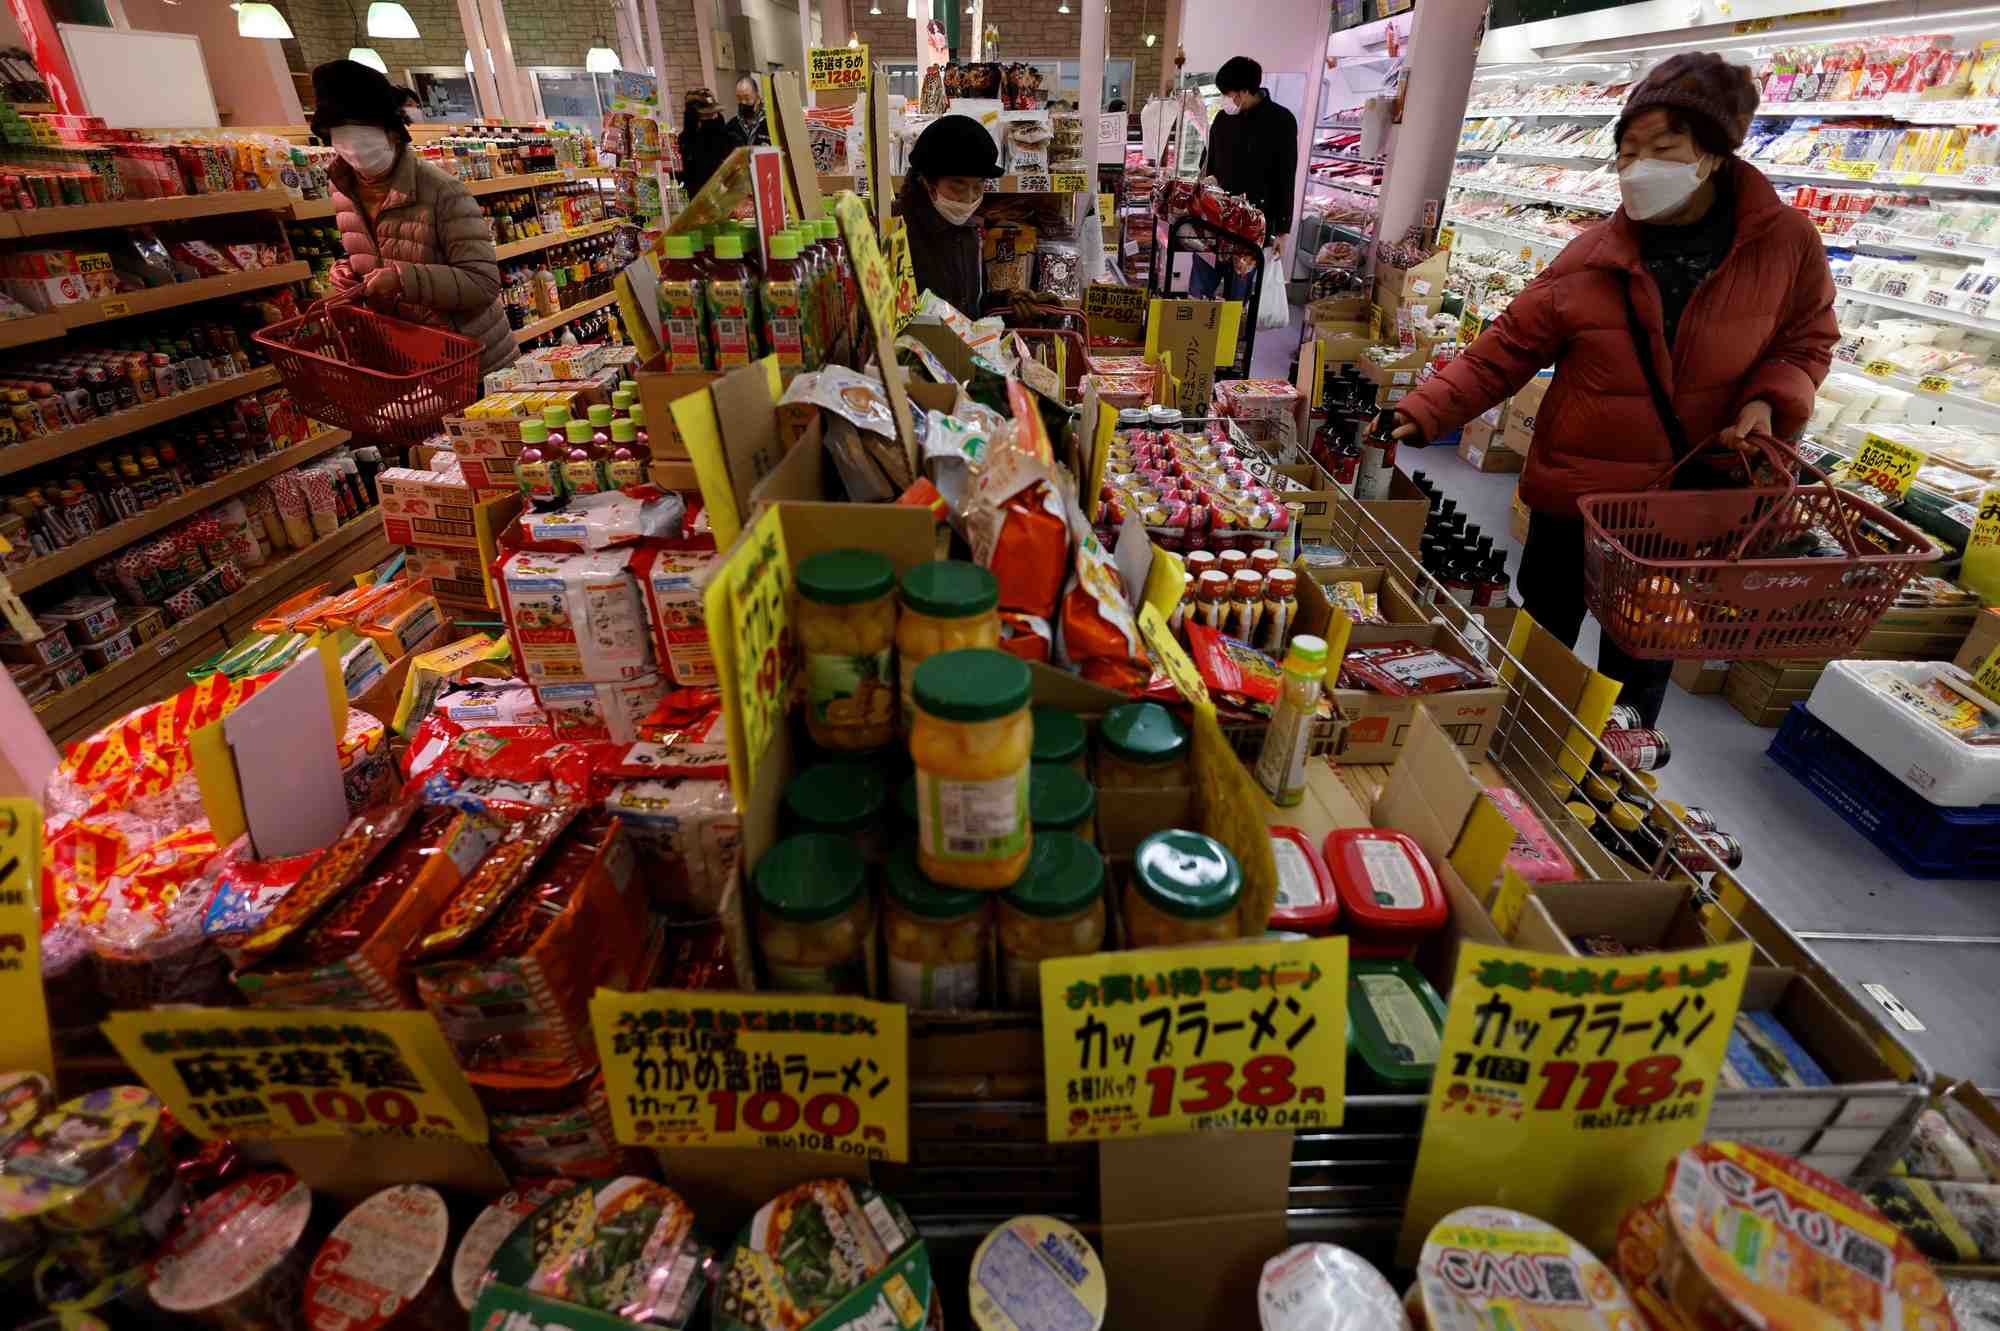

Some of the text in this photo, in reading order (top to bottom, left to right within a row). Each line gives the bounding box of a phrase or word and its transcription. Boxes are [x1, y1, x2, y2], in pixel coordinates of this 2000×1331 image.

[1075, 997, 1317, 1070] カップラーメン
[1473, 993, 1715, 1057] カップラーメン
[634, 1051, 892, 1097] わかめ醤油ラーメン
